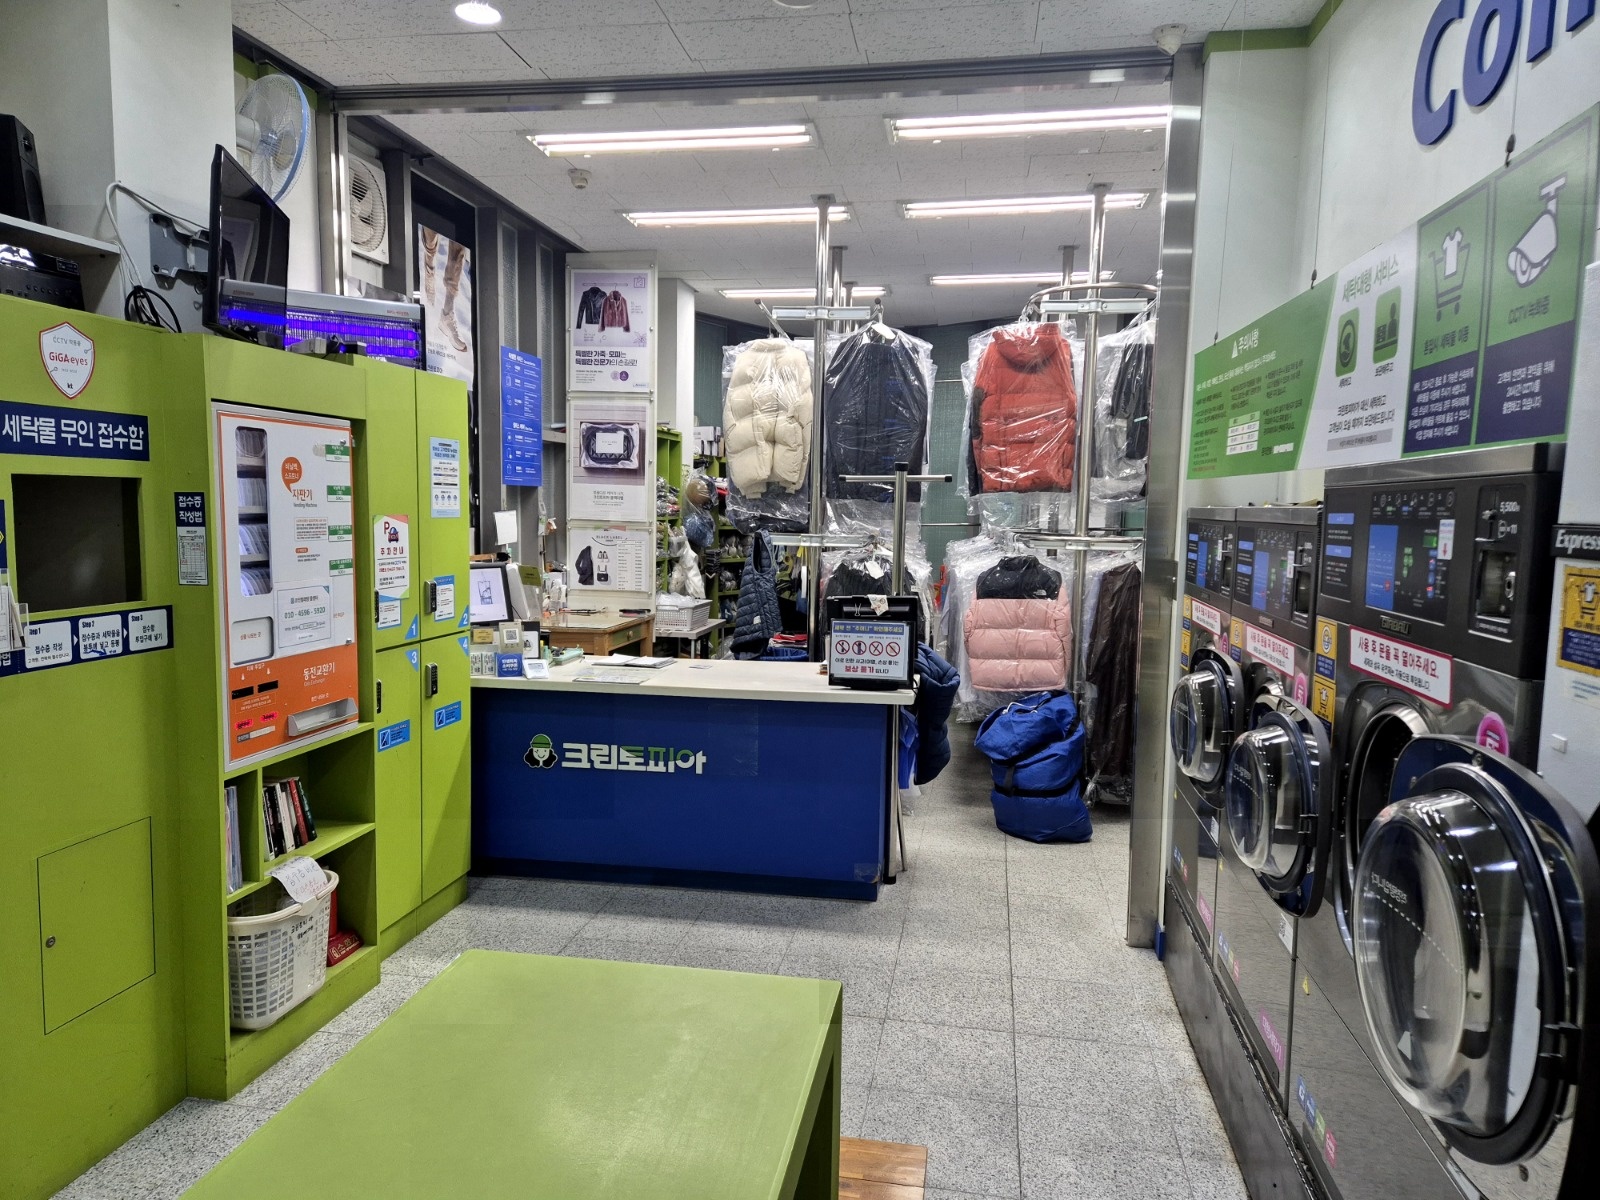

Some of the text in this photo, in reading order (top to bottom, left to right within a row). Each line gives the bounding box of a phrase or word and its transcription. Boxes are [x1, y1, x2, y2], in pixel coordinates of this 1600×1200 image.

[1341, 256, 1399, 302] 세탁대행 서비스
[53, 335, 67, 344] CCTV
[1238, 328, 1260, 357] 주의사항
[49, 351, 88, 368] GiGAeyes
[2, 414, 144, 451] 세탁물 무인 접수함
[293, 489, 312, 501] 자판기
[178, 496, 201, 508] 접수증
[179, 511, 202, 523] 작성법
[463, 614, 468, 625] 2
[412, 623, 416, 636] 1
[35, 643, 63, 655] 접수증 작성
[463, 639, 468, 649] 4
[411, 651, 417, 664] 3
[1358, 636, 1439, 679] 사용 후 문을 꼭 열어주세요.
[303, 662, 335, 680] 동전교환기
[561, 742, 707, 775] 크린토피아
